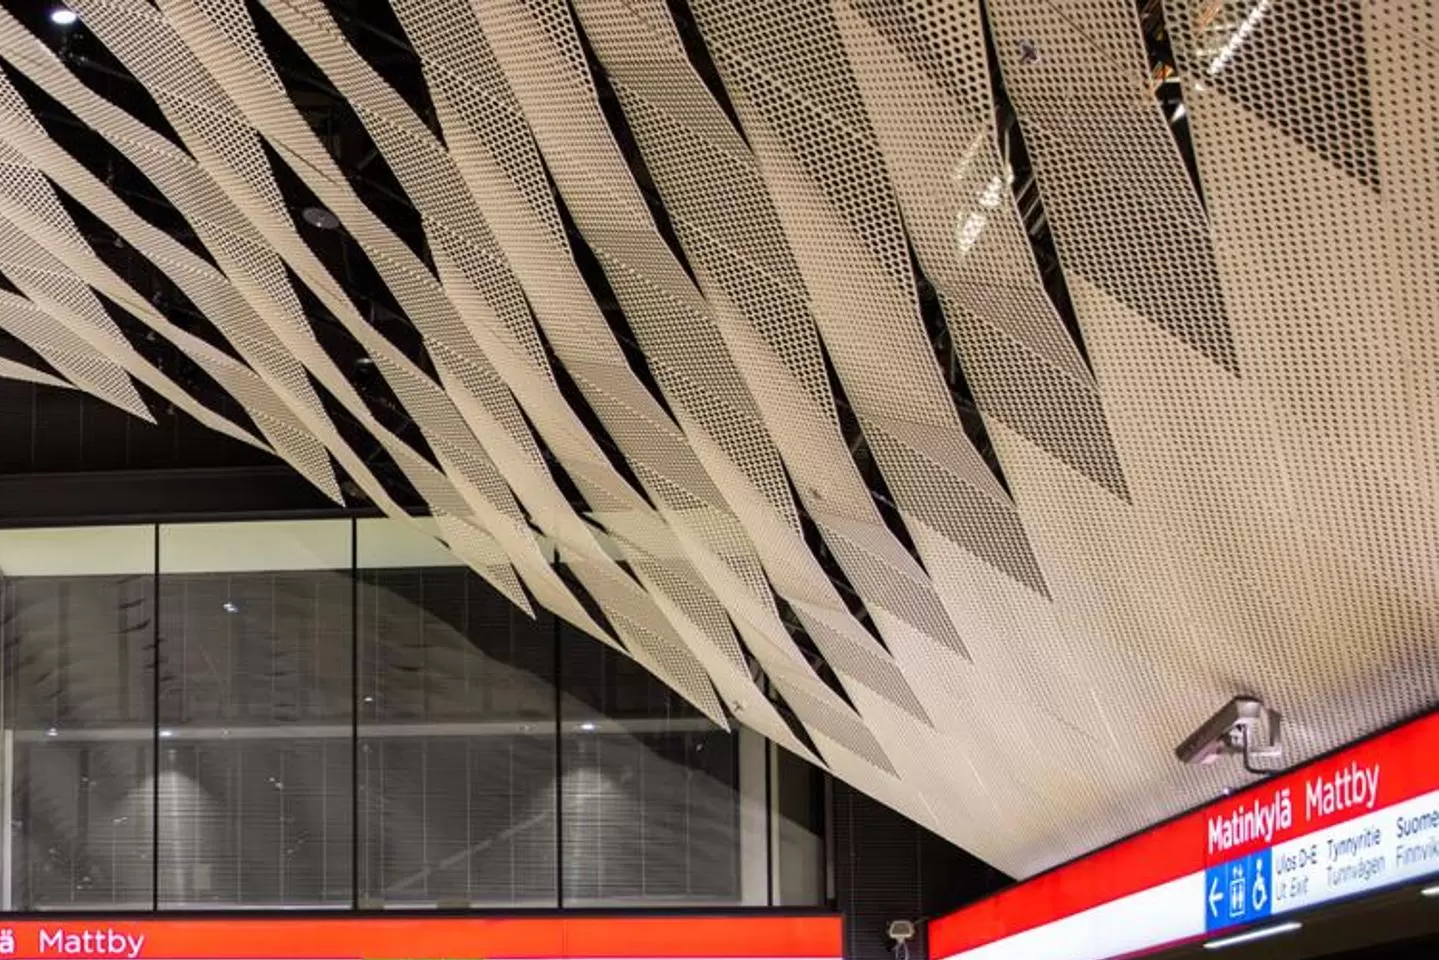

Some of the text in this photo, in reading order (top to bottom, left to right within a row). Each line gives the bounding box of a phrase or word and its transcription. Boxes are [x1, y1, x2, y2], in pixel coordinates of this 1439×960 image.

[1208, 760, 1380, 853] Matinkylä Mattby
[39, 931, 145, 958] Mattby
